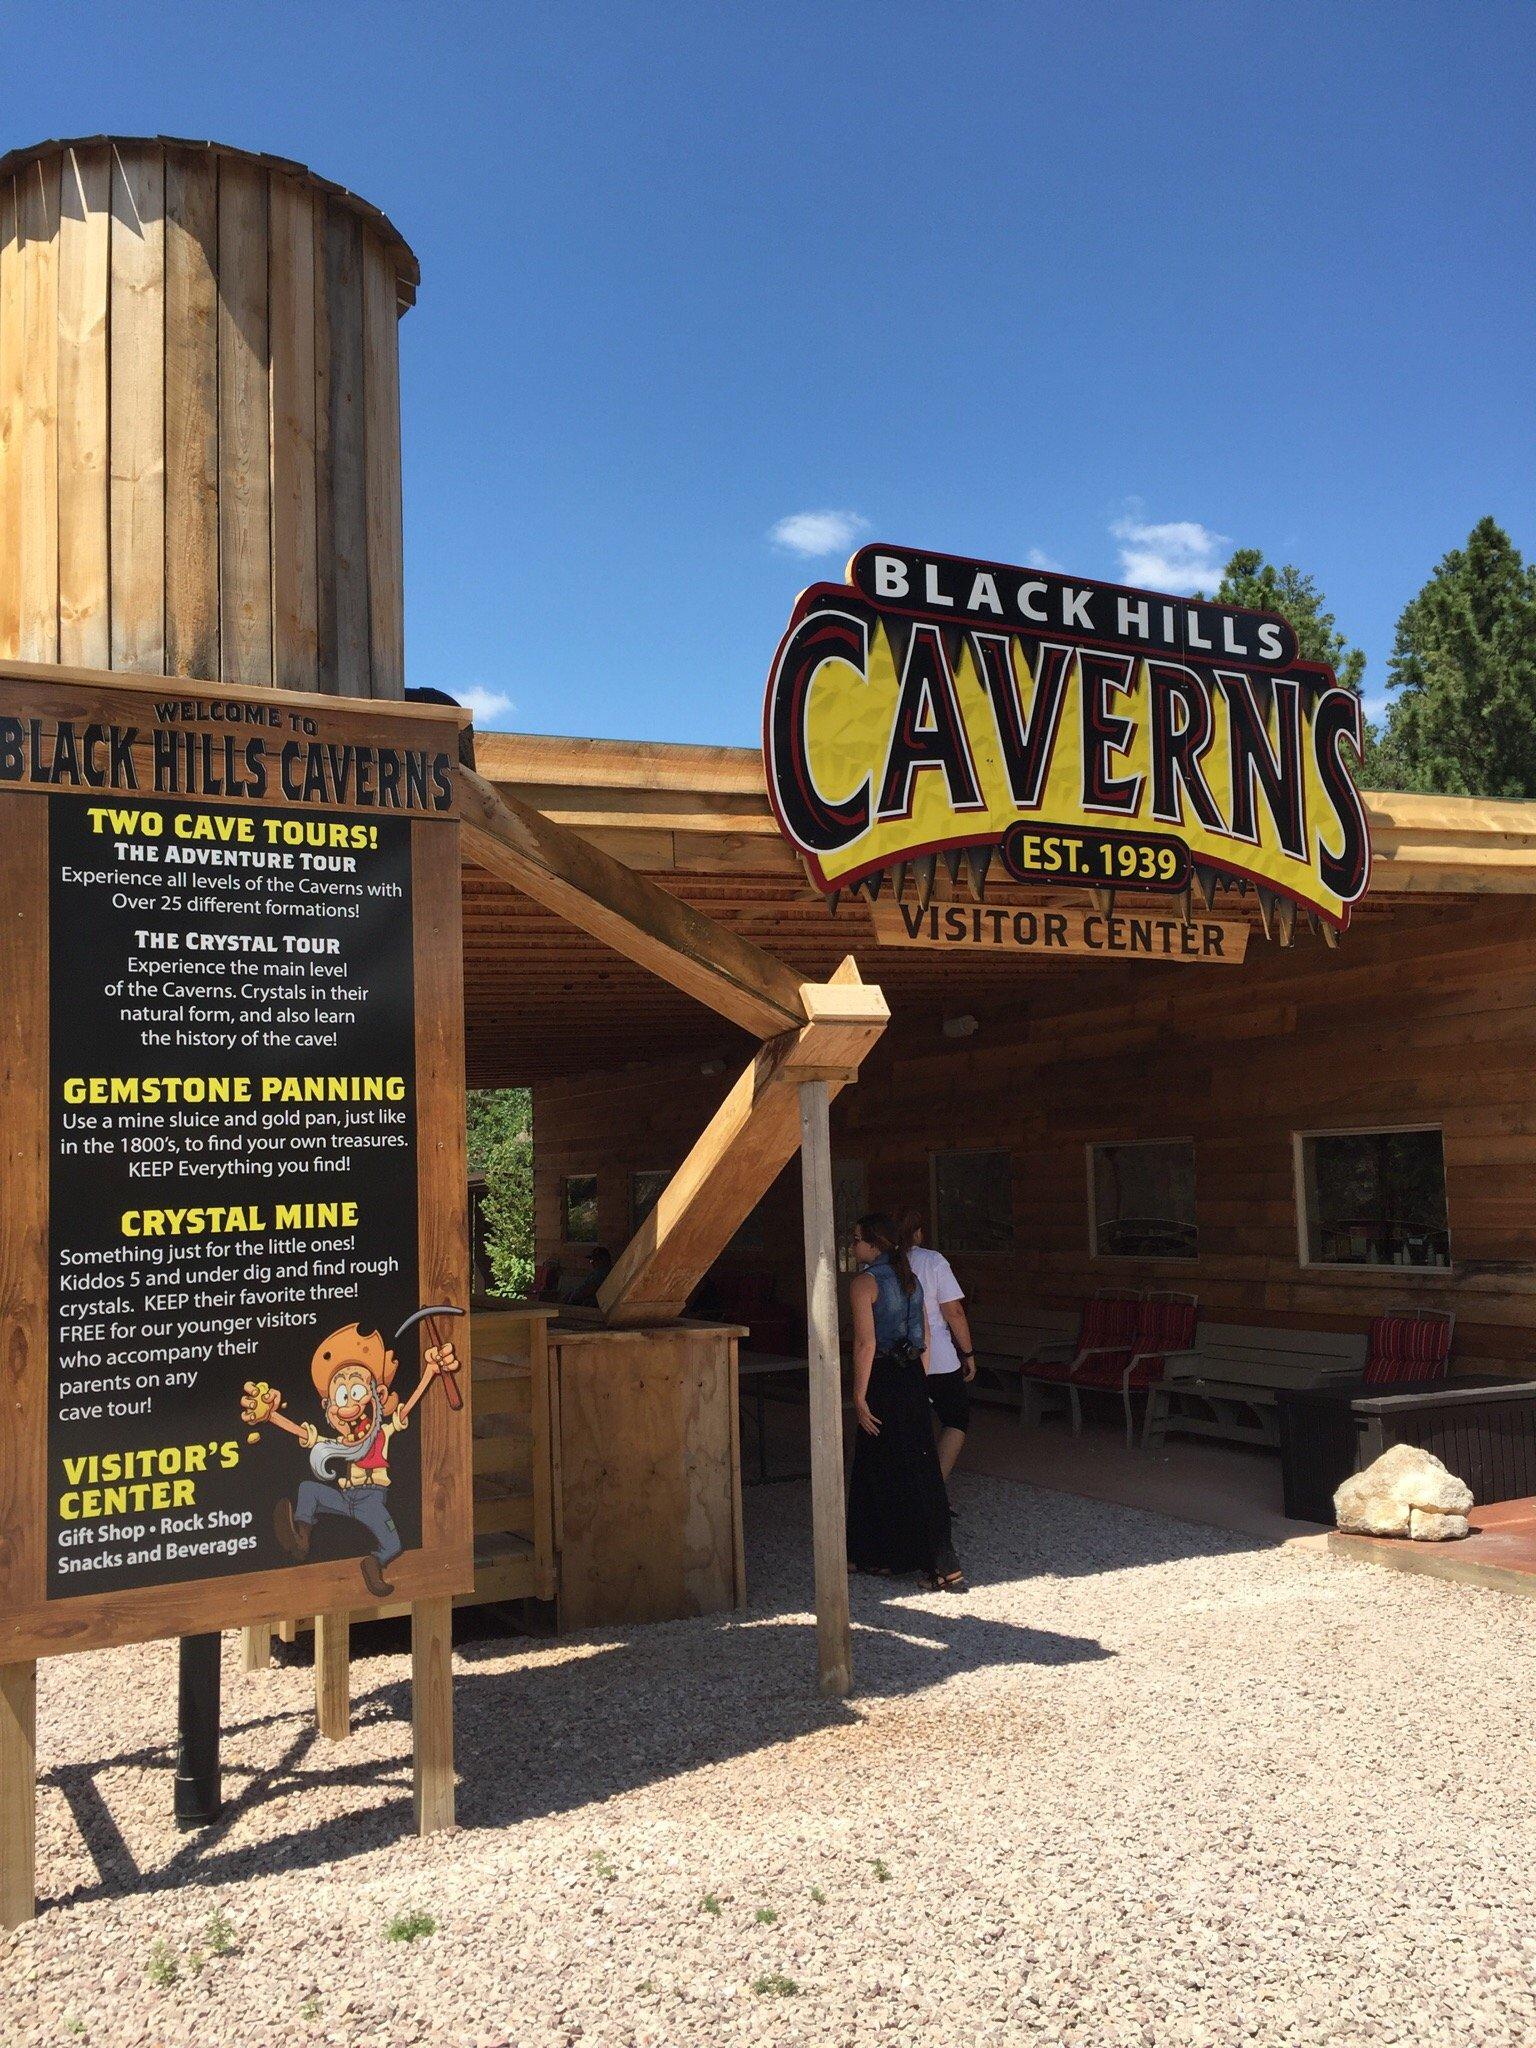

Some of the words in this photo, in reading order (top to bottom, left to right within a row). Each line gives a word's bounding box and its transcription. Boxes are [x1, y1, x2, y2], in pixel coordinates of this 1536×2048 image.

[874, 555, 1095, 630] BLACK
[1117, 594, 1284, 660] HILLS
[154, 701, 281, 726] WELCOME
[289, 713, 319, 736] TO
[0, 717, 139, 789] BLACK
[153, 729, 268, 798] HILLS
[280, 741, 454, 811] CAVERNS
[771, 610, 1371, 902] CAVERNS
[86, 807, 164, 837] TWO
[174, 813, 256, 843] CAVE
[262, 818, 378, 850] TOURS!
[113, 841, 160, 863] THE
[163, 844, 295, 870] ADVENTURE
[298, 852, 357, 873] TOUR
[1023, 835, 1090, 874] EST.
[1099, 843, 1177, 880] 1939
[61, 866, 163, 887] Experience
[166, 871, 187, 888] all
[192, 872, 241, 890] levels
[244, 875, 264, 891] of
[265, 876, 295, 893] the
[298, 878, 364, 896] Caverns
[366, 882, 403, 898] with
[111, 892, 157, 910] Over
[160, 895, 182, 911] 25
[186, 895, 262, 915] different
[264, 898, 360, 919] formations!
[134, 929, 180, 950] THE
[185, 931, 279, 953] CRYSTAL
[282, 935, 341, 955] TOUR
[901, 904, 1067, 948] VISITOR
[1083, 916, 1226, 956] CENTER
[128, 956, 226, 977] Experience
[229, 959, 259, 976] the
[263, 961, 305, 977] main
[309, 961, 348, 978] level
[104, 979, 125, 997] of
[127, 980, 159, 997] the
[162, 981, 237, 999] Caverns.
[240, 983, 307, 1003] Crystals
[310, 985, 326, 1000] in
[330, 984, 370, 1001] their
[120, 1005, 184, 1022] natural
[187, 1005, 235, 1025] form,
[239, 1006, 272, 1023] and
[276, 1006, 311, 1024] also
[314, 1007, 355, 1024] learn
[140, 1029, 172, 1046] the
[176, 1029, 238, 1050] history
[240, 1030, 259, 1046] of
[262, 1030, 292, 1047] the
[294, 1031, 338, 1047] cave!
[63, 1077, 252, 1104] GEMSTONE
[261, 1076, 406, 1102] PANNING
[62, 1112, 98, 1130] Use
[101, 1116, 113, 1129] a
[118, 1112, 165, 1129] mine
[169, 1110, 220, 1128] sluice
[223, 1109, 257, 1127] and
[261, 1109, 301, 1130] gold
[305, 1113, 342, 1129] pan,
[343, 1109, 375, 1129] just
[378, 1108, 407, 1124] like
[60, 1138, 78, 1155] in
[82, 1137, 115, 1154] the
[120, 1135, 181, 1154] 1800's,
[184, 1137, 204, 1152] to
[207, 1134, 243, 1151] find
[246, 1137, 287, 1155] your
[289, 1136, 327, 1149] own
[330, 1134, 409, 1149] treasures.
[128, 1160, 174, 1178] KEEP
[178, 1158, 273, 1180] Everything
[277, 1160, 309, 1178] you
[312, 1155, 351, 1172] find!
[121, 1205, 267, 1237] CRYSTAL
[275, 1201, 359, 1230] MINE
[59, 1245, 164, 1266] Something
[166, 1243, 202, 1265] just
[205, 1240, 231, 1258] for
[234, 1239, 265, 1257] the
[268, 1237, 307, 1255] little
[310, 1234, 355, 1253] ones!
[60, 1271, 125, 1292] Kiddos
[129, 1271, 141, 1288] 5
[145, 1267, 181, 1287] and
[185, 1265, 240, 1284] under
[243, 1263, 271, 1284] dig
[275, 1260, 308, 1279] and
[312, 1258, 346, 1276] find
[350, 1255, 399, 1277] rough
[59, 1296, 135, 1321] crystals.
[144, 1292, 190, 1312] KEEP
[193, 1290, 236, 1309] their
[239, 1286, 306, 1305] favorite
[309, 1282, 359, 1301] three!
[60, 1323, 106, 1343] FREE
[109, 1321, 137, 1340] for
[140, 1322, 174, 1337] our
[176, 1316, 253, 1342] younger
[256, 1311, 317, 1329] visitors
[58, 1350, 102, 1369] who
[106, 1344, 213, 1366] accompany
[216, 1338, 259, 1357] their
[59, 1374, 131, 1400] parents
[135, 1374, 160, 1389] on
[164, 1371, 198, 1389] any
[58, 1405, 103, 1422] cave
[106, 1396, 152, 1417] tour!
[61, 1440, 240, 1486] VISITOR'S
[58, 1478, 197, 1521] CENTER
[57, 1526, 95, 1548] Gift
[97, 1523, 146, 1543] Shop
[160, 1512, 205, 1535] Rock
[207, 1509, 253, 1529] Shop
[57, 1550, 123, 1575] Snacks
[126, 1543, 162, 1566] and
[165, 1535, 258, 1560] Beverages
